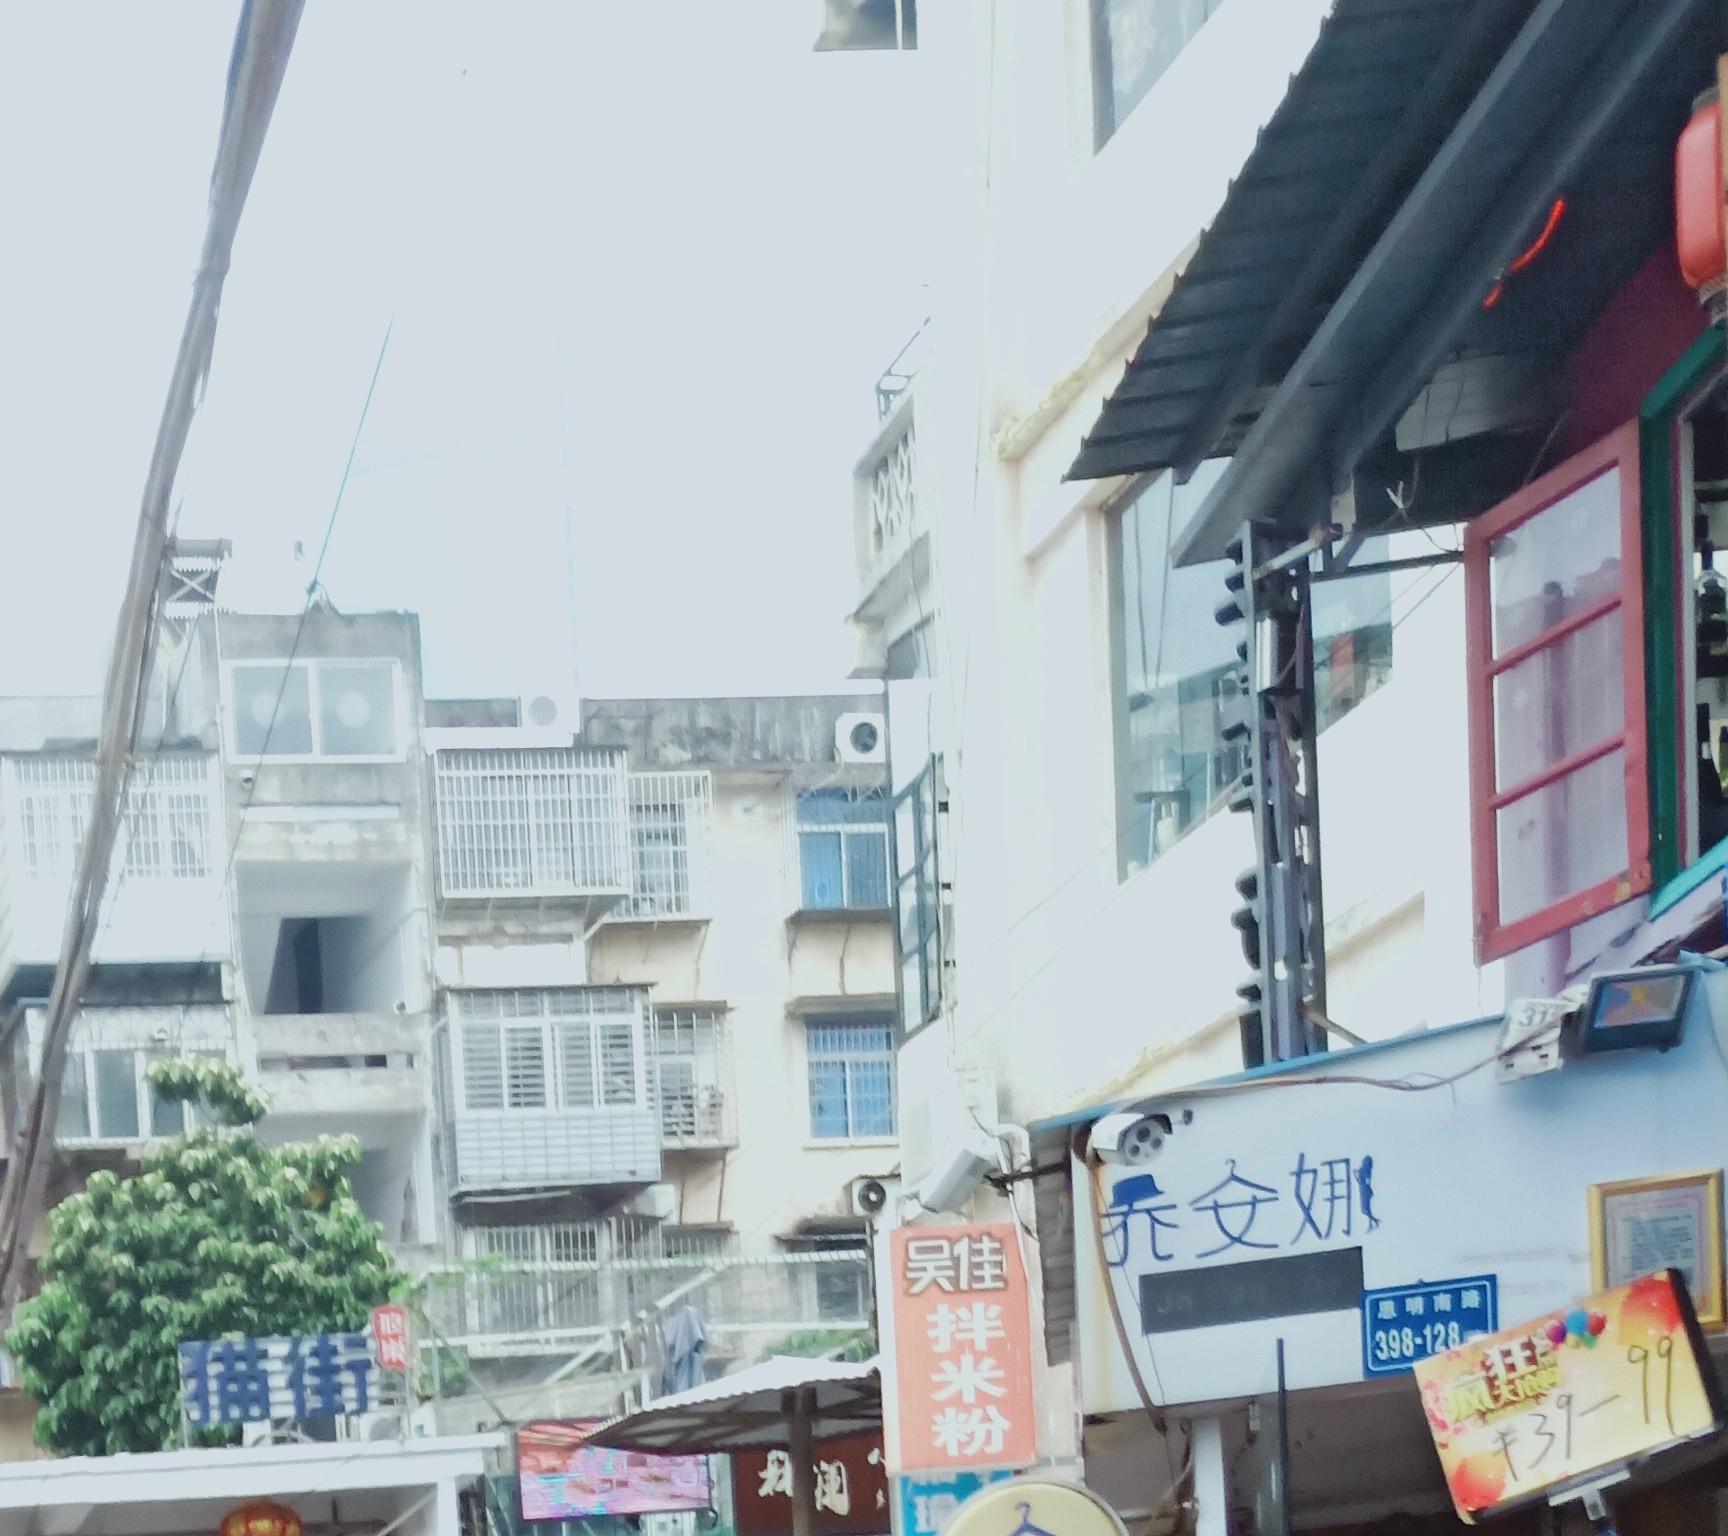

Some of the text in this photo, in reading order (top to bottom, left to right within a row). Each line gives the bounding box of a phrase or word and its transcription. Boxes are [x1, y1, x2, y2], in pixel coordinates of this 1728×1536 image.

[905, 1236, 1008, 1294] 吴佳
[927, 1302, 1010, 1458] 拌米粉
